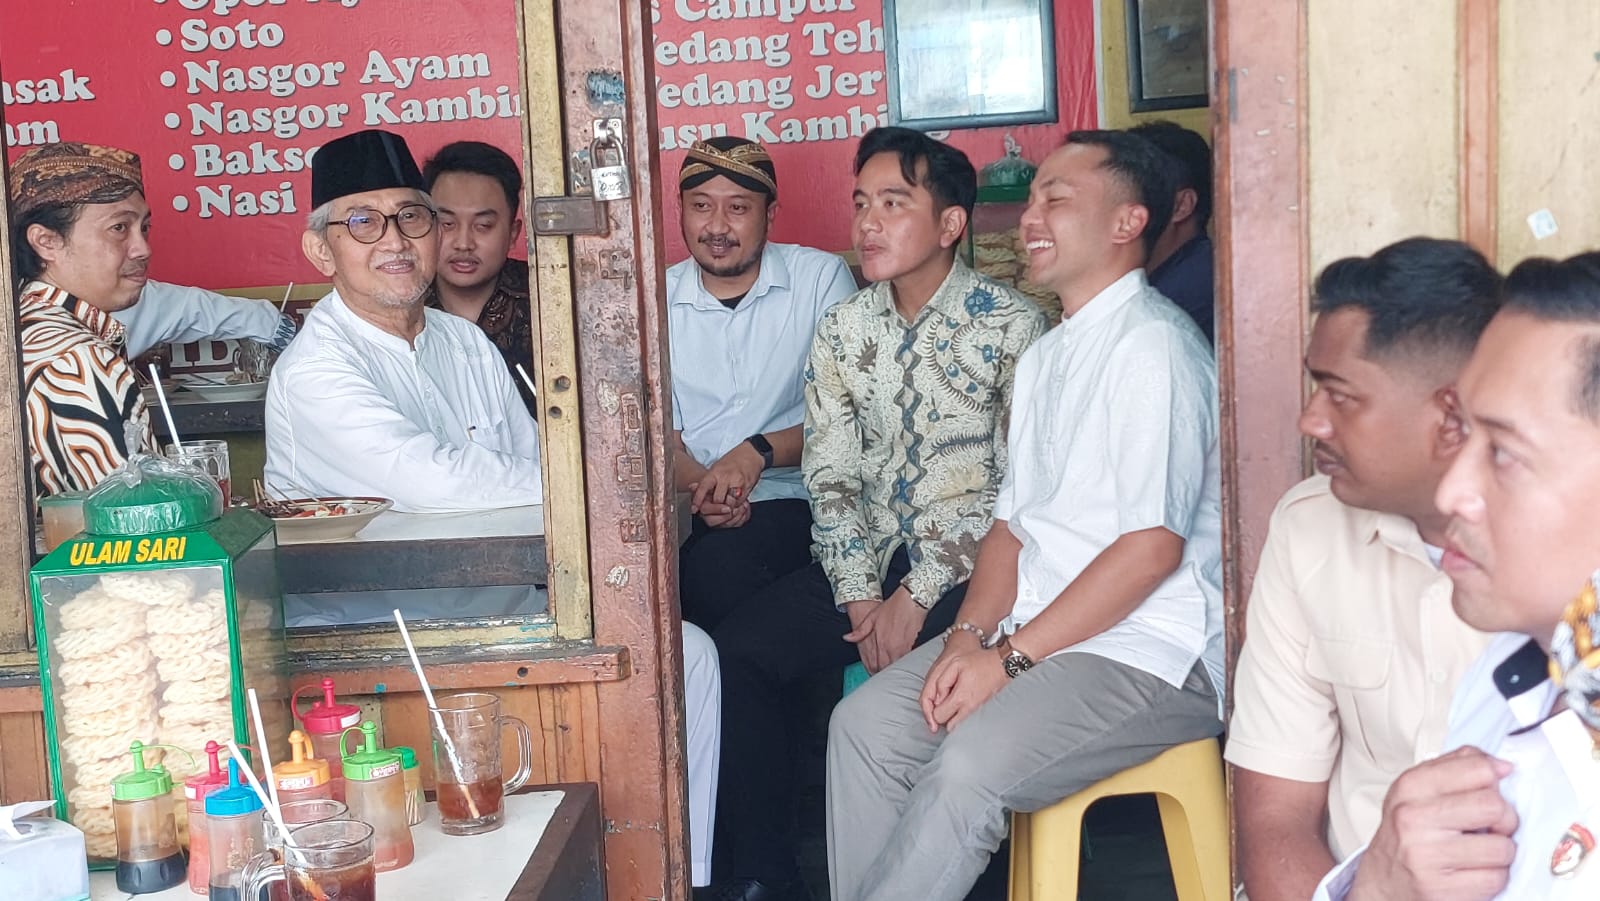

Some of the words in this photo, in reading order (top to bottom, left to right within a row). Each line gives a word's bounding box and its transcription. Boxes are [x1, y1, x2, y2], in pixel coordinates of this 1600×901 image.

[180, 19, 284, 51] Soto
[653, 31, 791, 67] edang
[802, 20, 884, 56] Teh
[184, 60, 345, 97] Nasgor
[360, 50, 491, 89] Ayam
[655, 73, 794, 109] edang
[805, 65, 886, 99] Jer
[188, 101, 349, 139] Nasgor
[362, 85, 520, 126] Kambi
[659, 122, 728, 151] usu
[741, 102, 950, 144] Kambi
[195, 181, 297, 218] Nasi
[70, 540, 132, 566] ULAM
[135, 536, 187, 563] SARI
